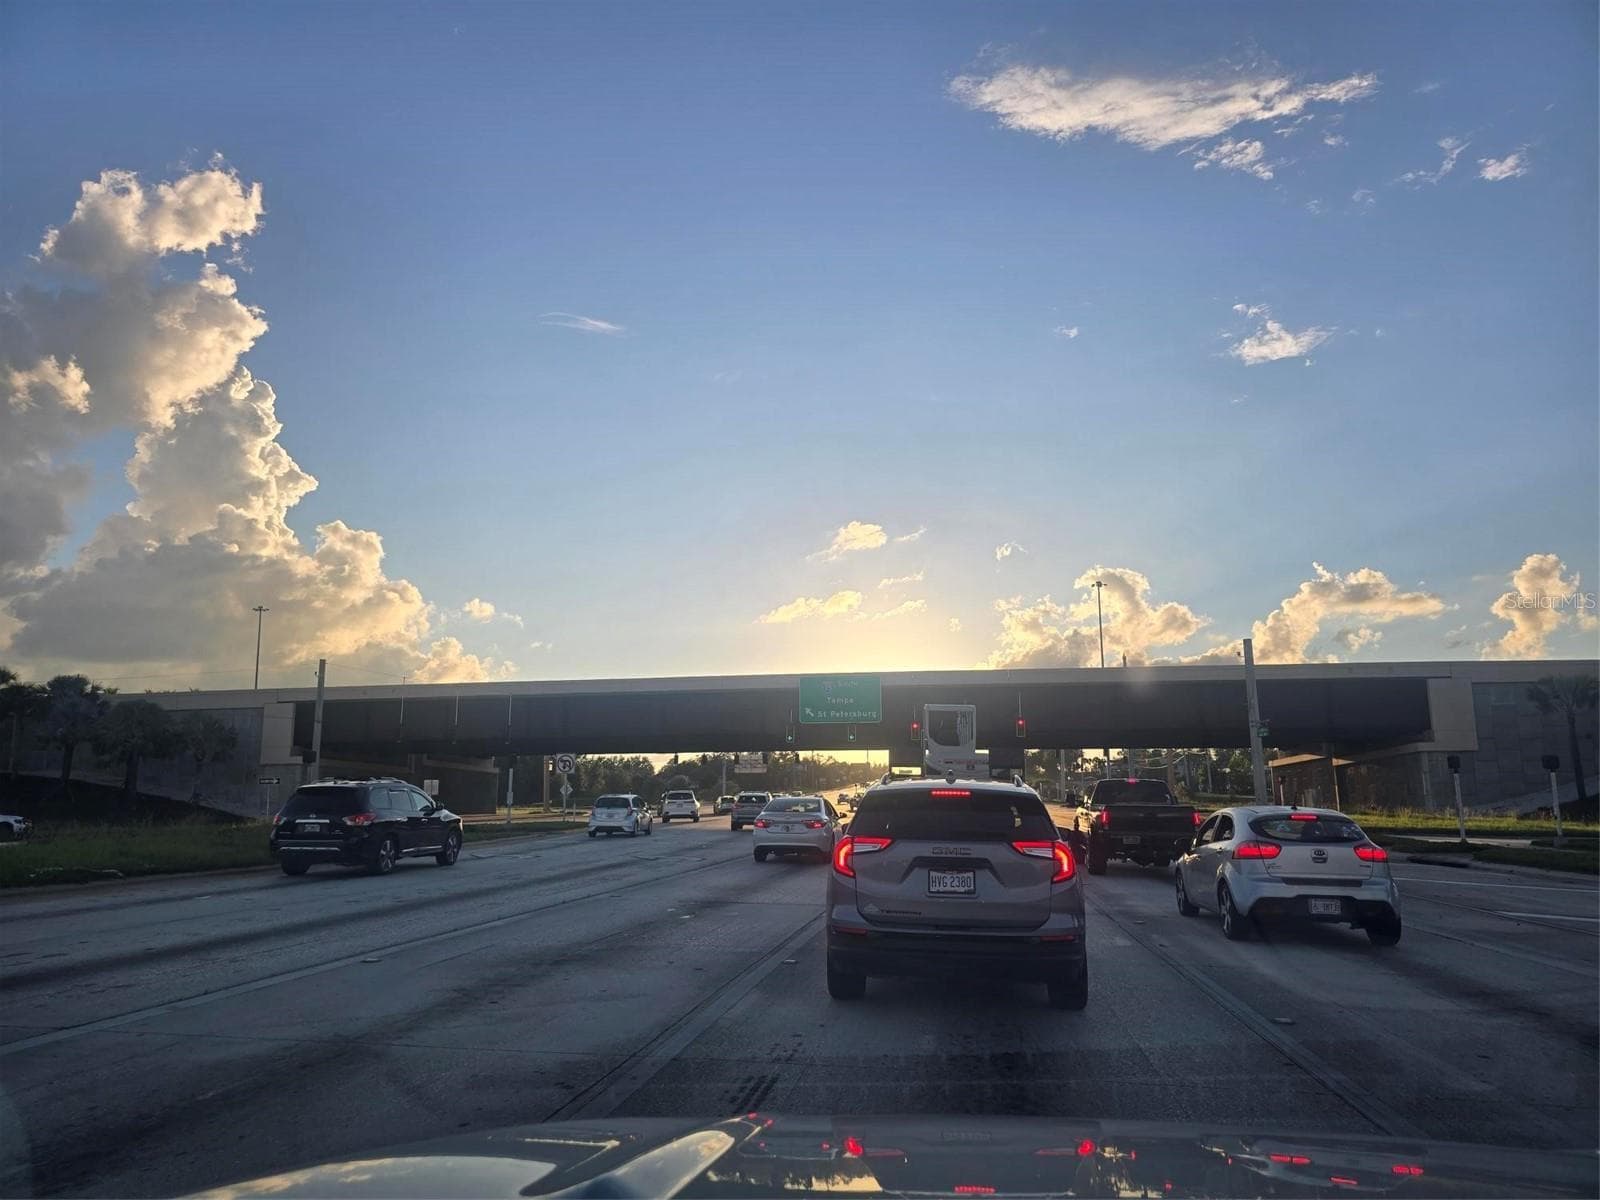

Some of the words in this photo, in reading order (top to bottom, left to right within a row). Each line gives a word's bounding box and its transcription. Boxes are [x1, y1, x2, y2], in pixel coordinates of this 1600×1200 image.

[826, 696, 855, 705] Tampa
[830, 710, 877, 719] Petersburg
[931, 846, 972, 856] GMC
[931, 875, 948, 889] HVG
[950, 875, 972, 888] 2380
